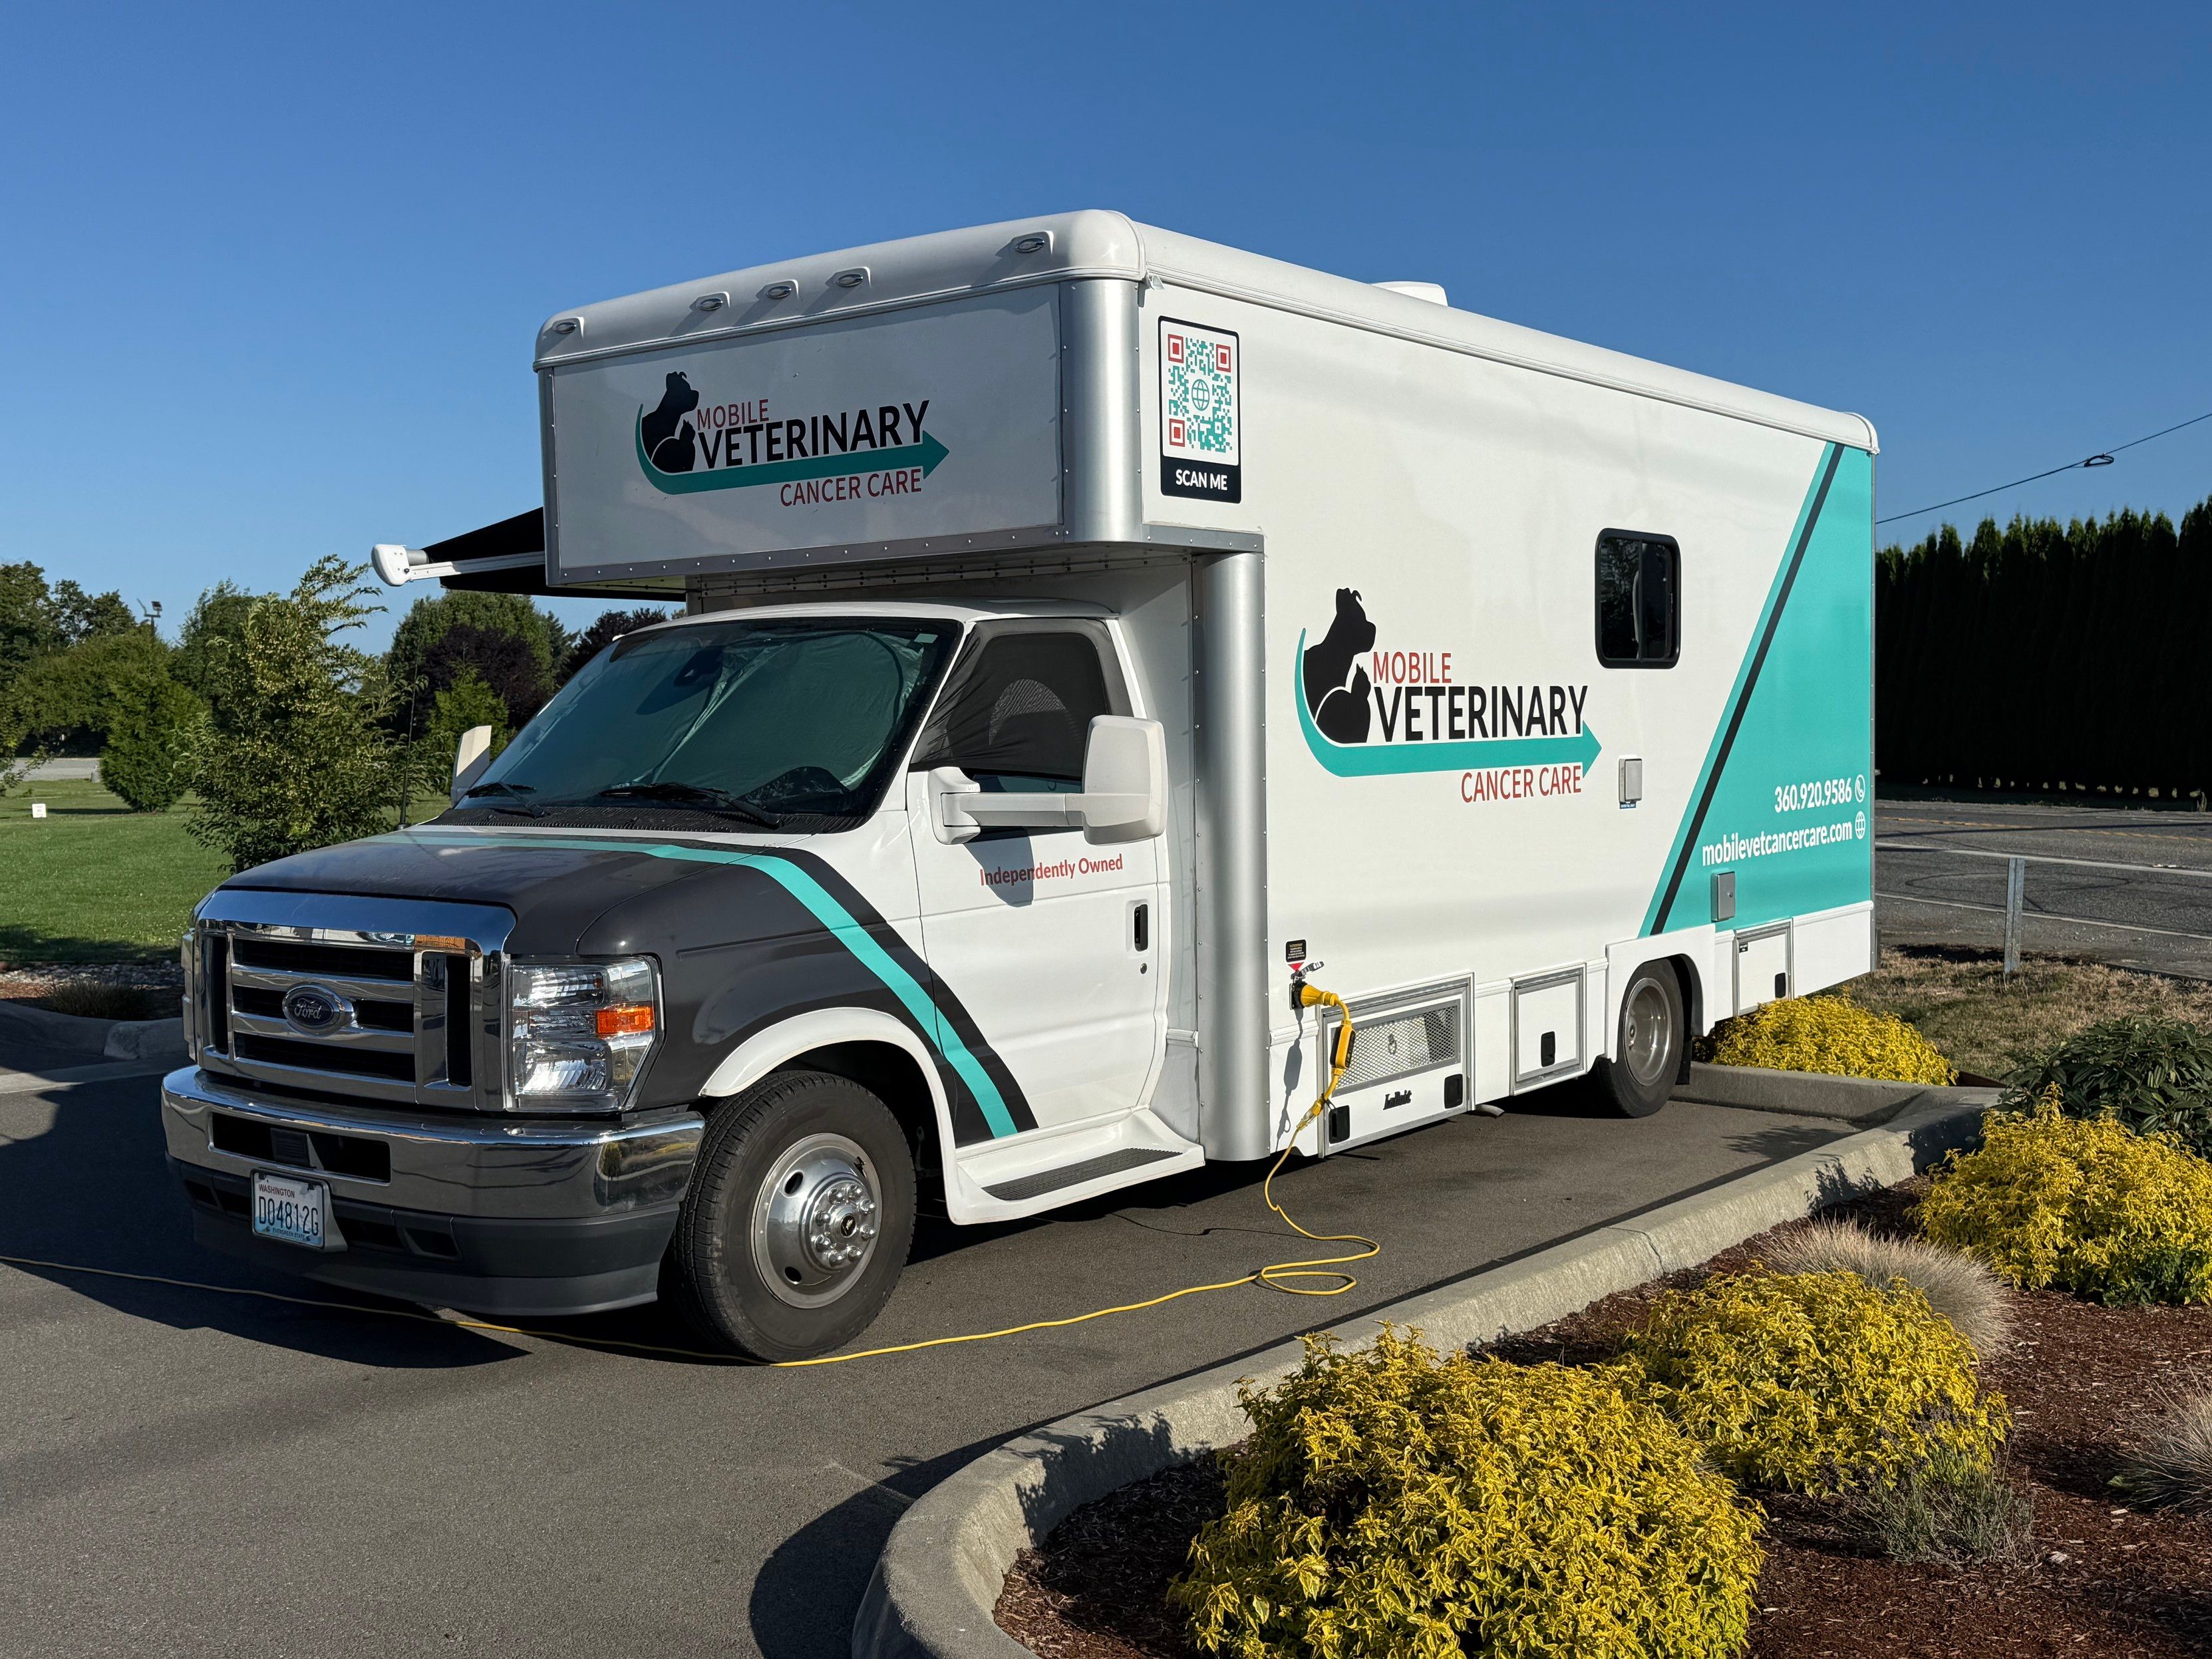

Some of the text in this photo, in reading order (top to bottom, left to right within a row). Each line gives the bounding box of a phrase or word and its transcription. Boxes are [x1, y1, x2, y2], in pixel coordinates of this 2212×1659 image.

[697, 398, 770, 430] MOBILE
[697, 399, 930, 470] VETERINARY
[780, 468, 923, 507] CANCER CARE
[1175, 468, 1228, 491] SCAN ME
[1372, 651, 1452, 684] MOBILE
[1374, 685, 1589, 742] VETERINARY
[1461, 766, 1582, 804] CANCER CARE
[1774, 777, 1853, 813] 360.920.9586
[1702, 821, 1853, 866] mobilevetcancercare.com
[979, 853, 1123, 886] Independently Owned
[294, 998, 322, 1019] Ford
[258, 1183, 295, 1198] WASHINGTON
[272, 1227, 293, 1237] EVERGREEN
